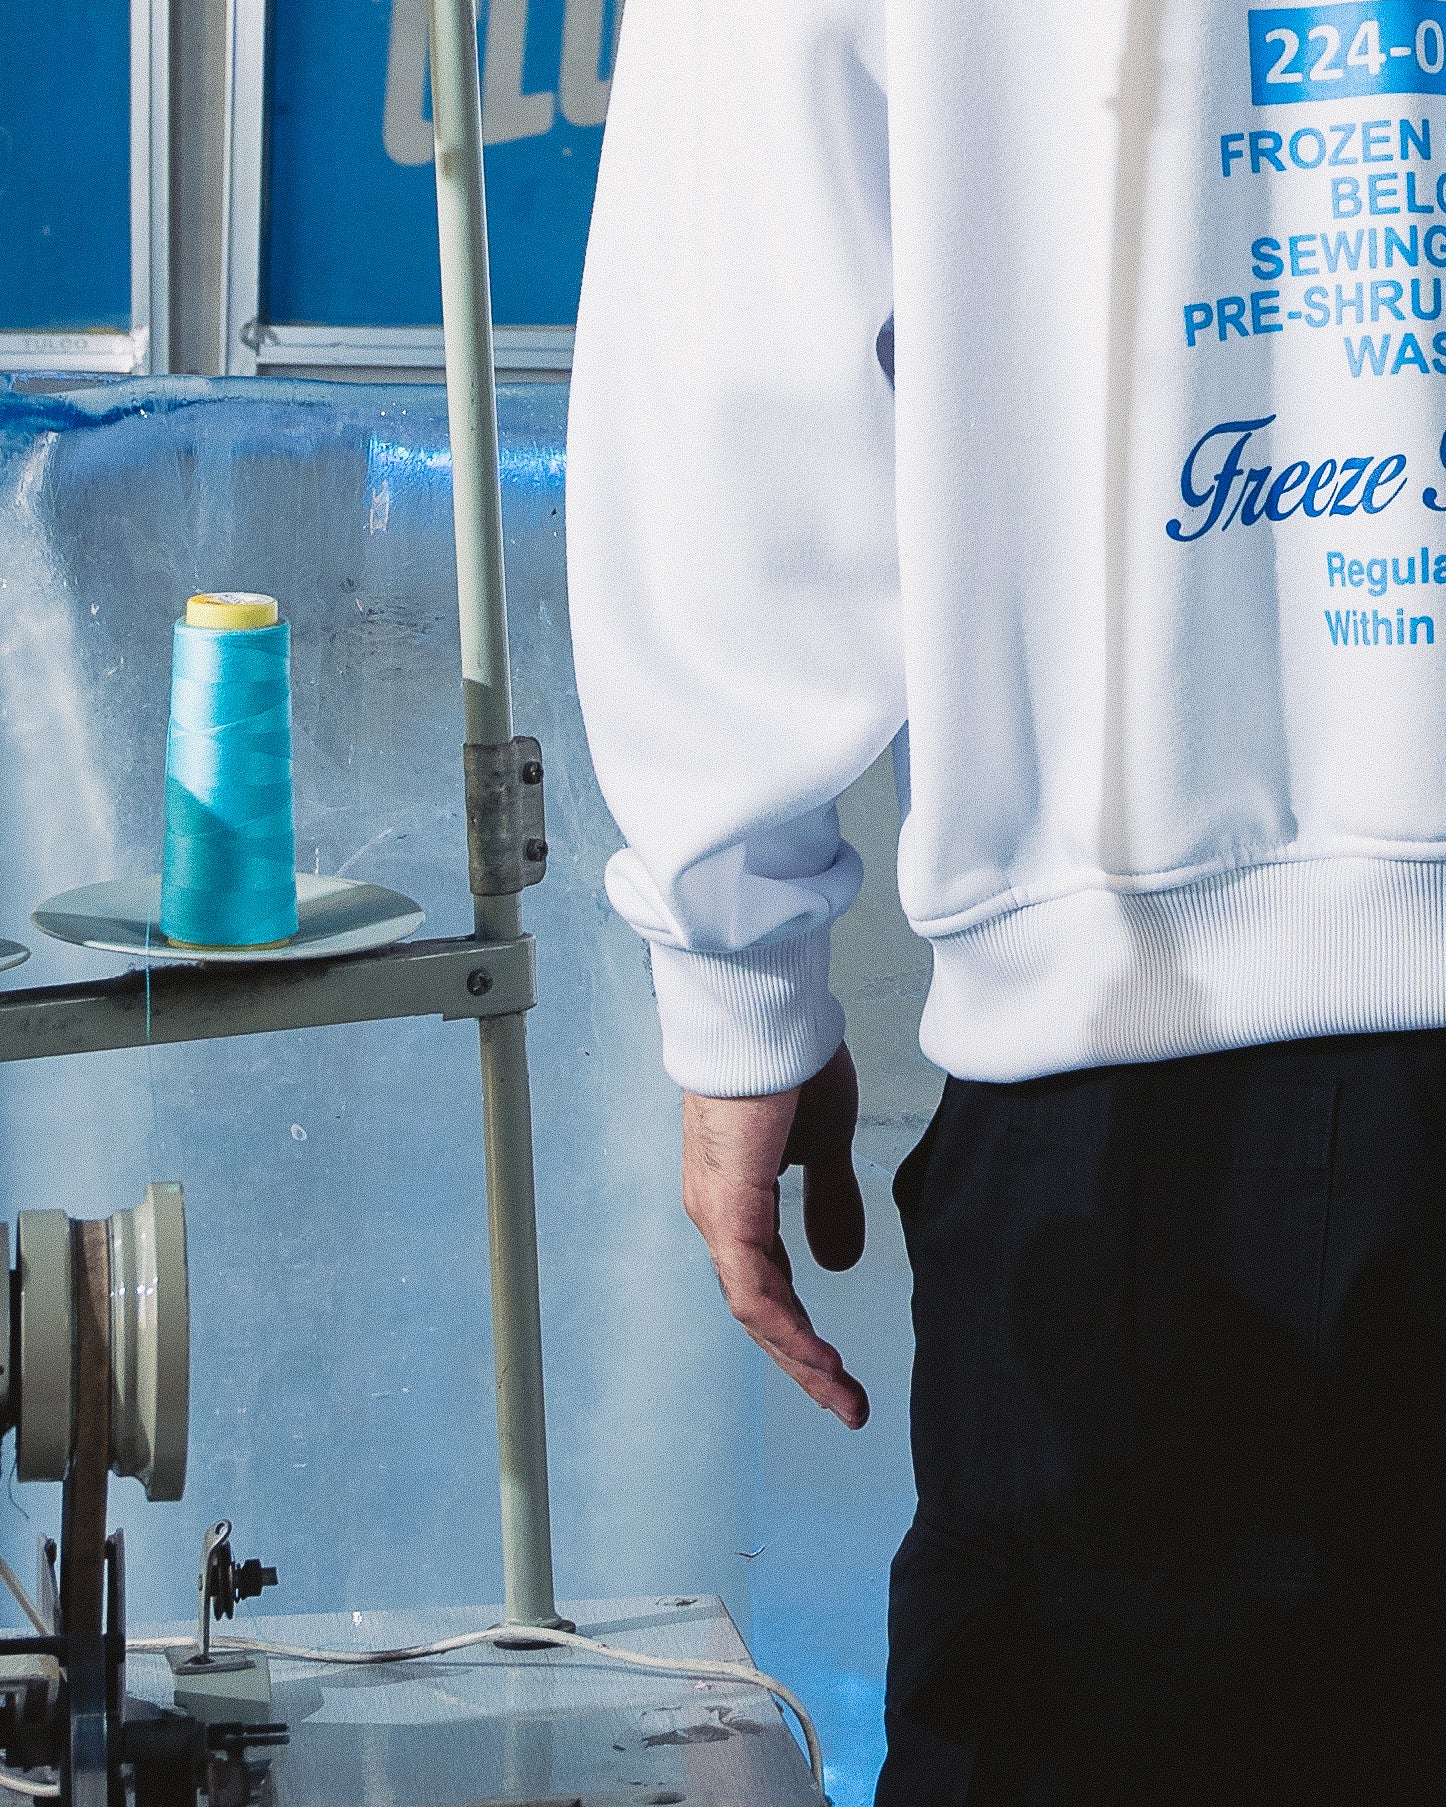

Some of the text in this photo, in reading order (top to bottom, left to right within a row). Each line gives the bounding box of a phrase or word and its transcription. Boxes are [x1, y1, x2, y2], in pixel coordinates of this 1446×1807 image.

[1219, 118, 1432, 178] FROZEN
[1165, 413, 1408, 543] Freeze
[1324, 608, 1435, 646] Within
